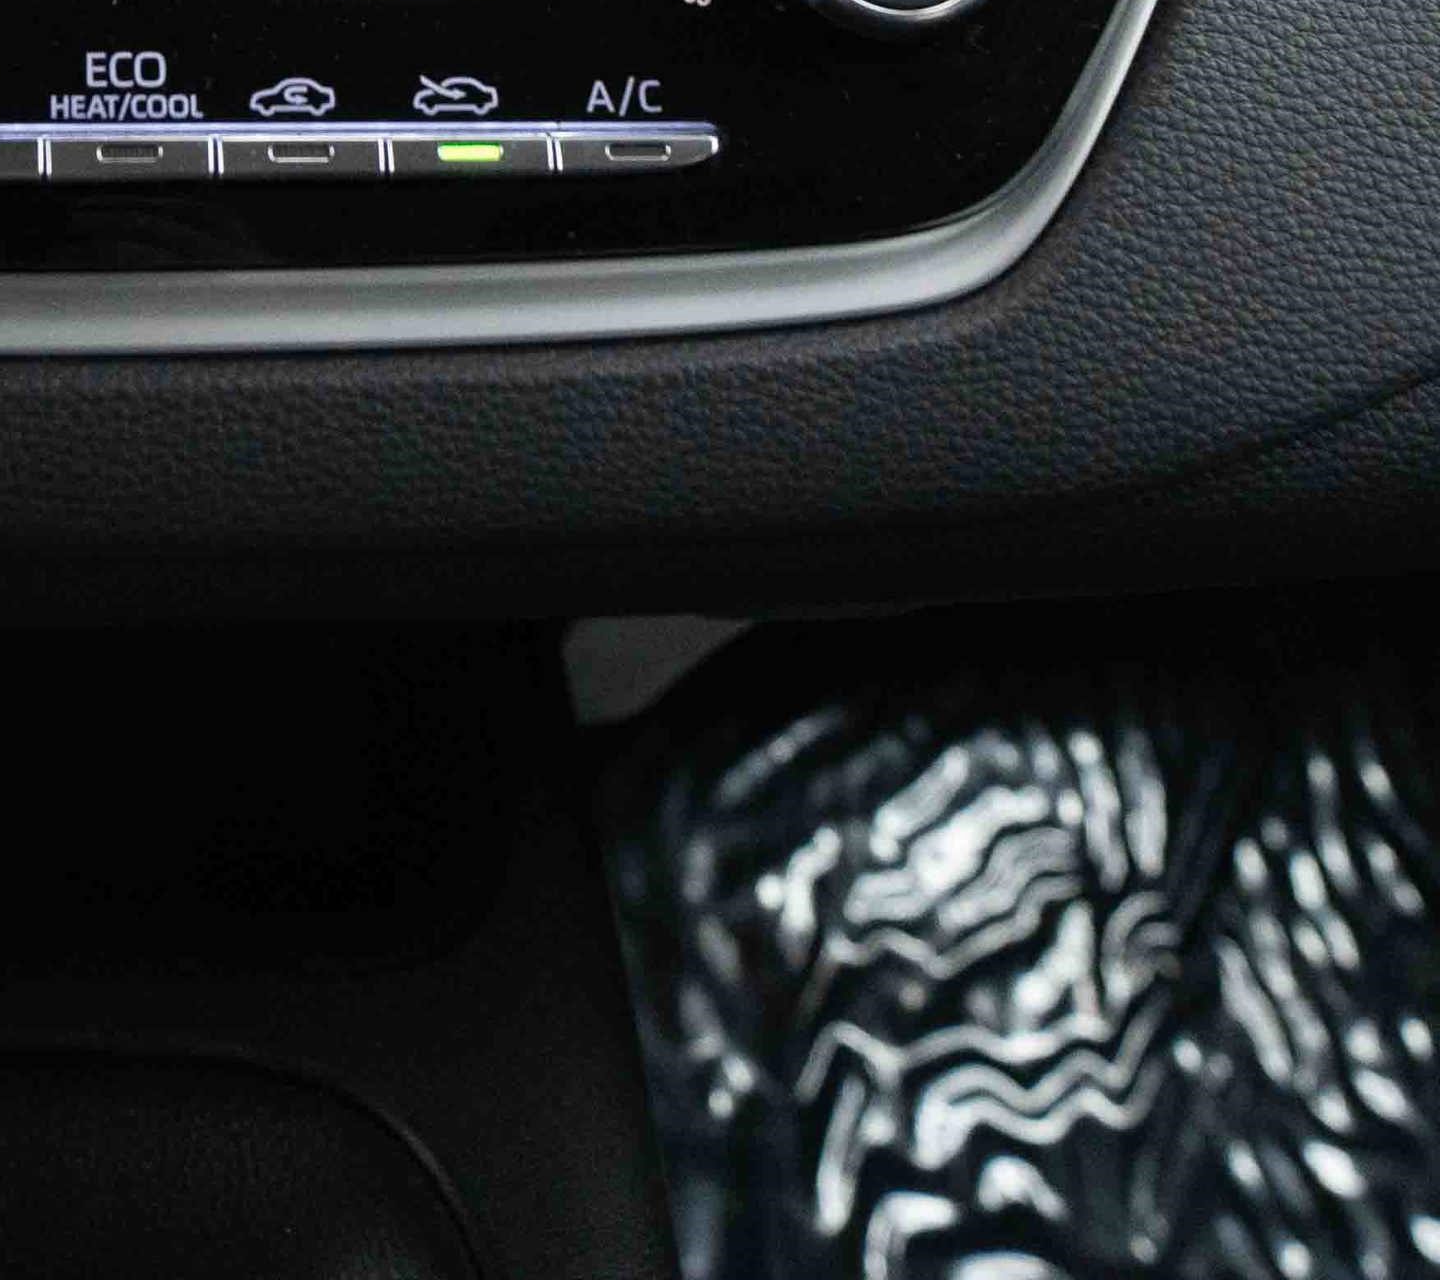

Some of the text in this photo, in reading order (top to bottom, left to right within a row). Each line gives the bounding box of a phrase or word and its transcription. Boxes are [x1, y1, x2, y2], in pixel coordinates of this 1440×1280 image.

[85, 51, 167, 89] ECO
[49, 93, 204, 121] HEAT/COOL
[586, 78, 662, 114] A/C
